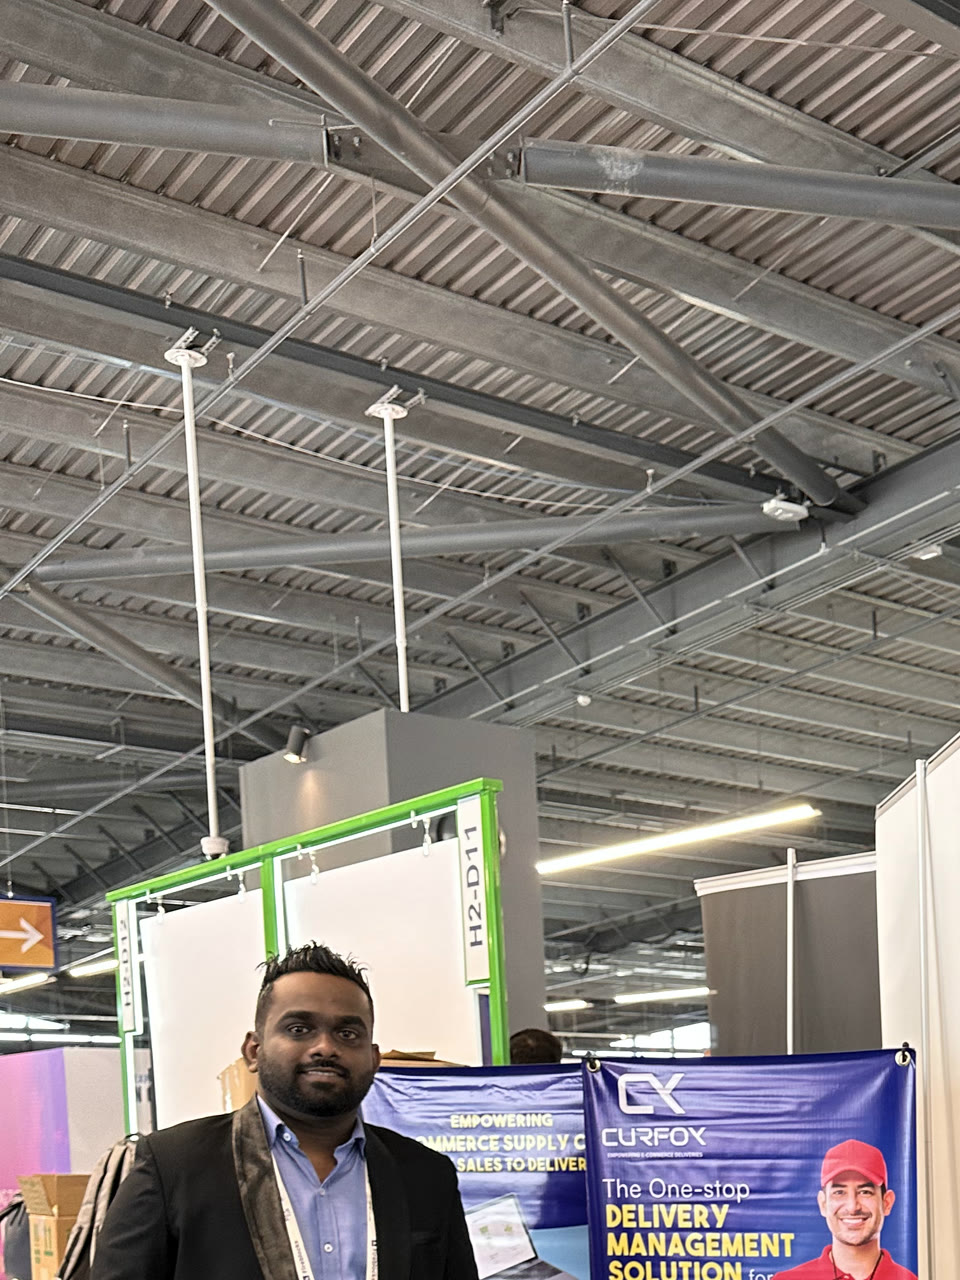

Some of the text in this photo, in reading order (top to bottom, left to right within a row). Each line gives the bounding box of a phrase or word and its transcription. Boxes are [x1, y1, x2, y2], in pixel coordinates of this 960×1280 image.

[463, 826, 483, 949] H2-D11
[450, 1113, 553, 1129] EMPOWERING
[415, 1134, 499, 1153] OMMERCE
[502, 1133, 568, 1151] SUPPLY
[601, 1126, 707, 1147] CURFOX
[456, 1156, 586, 1172] SALES TO DELIVER
[602, 1177, 750, 1203] The One-stop
[606, 1203, 729, 1229] DELIVERY
[606, 1232, 795, 1257] MANAGEMENT
